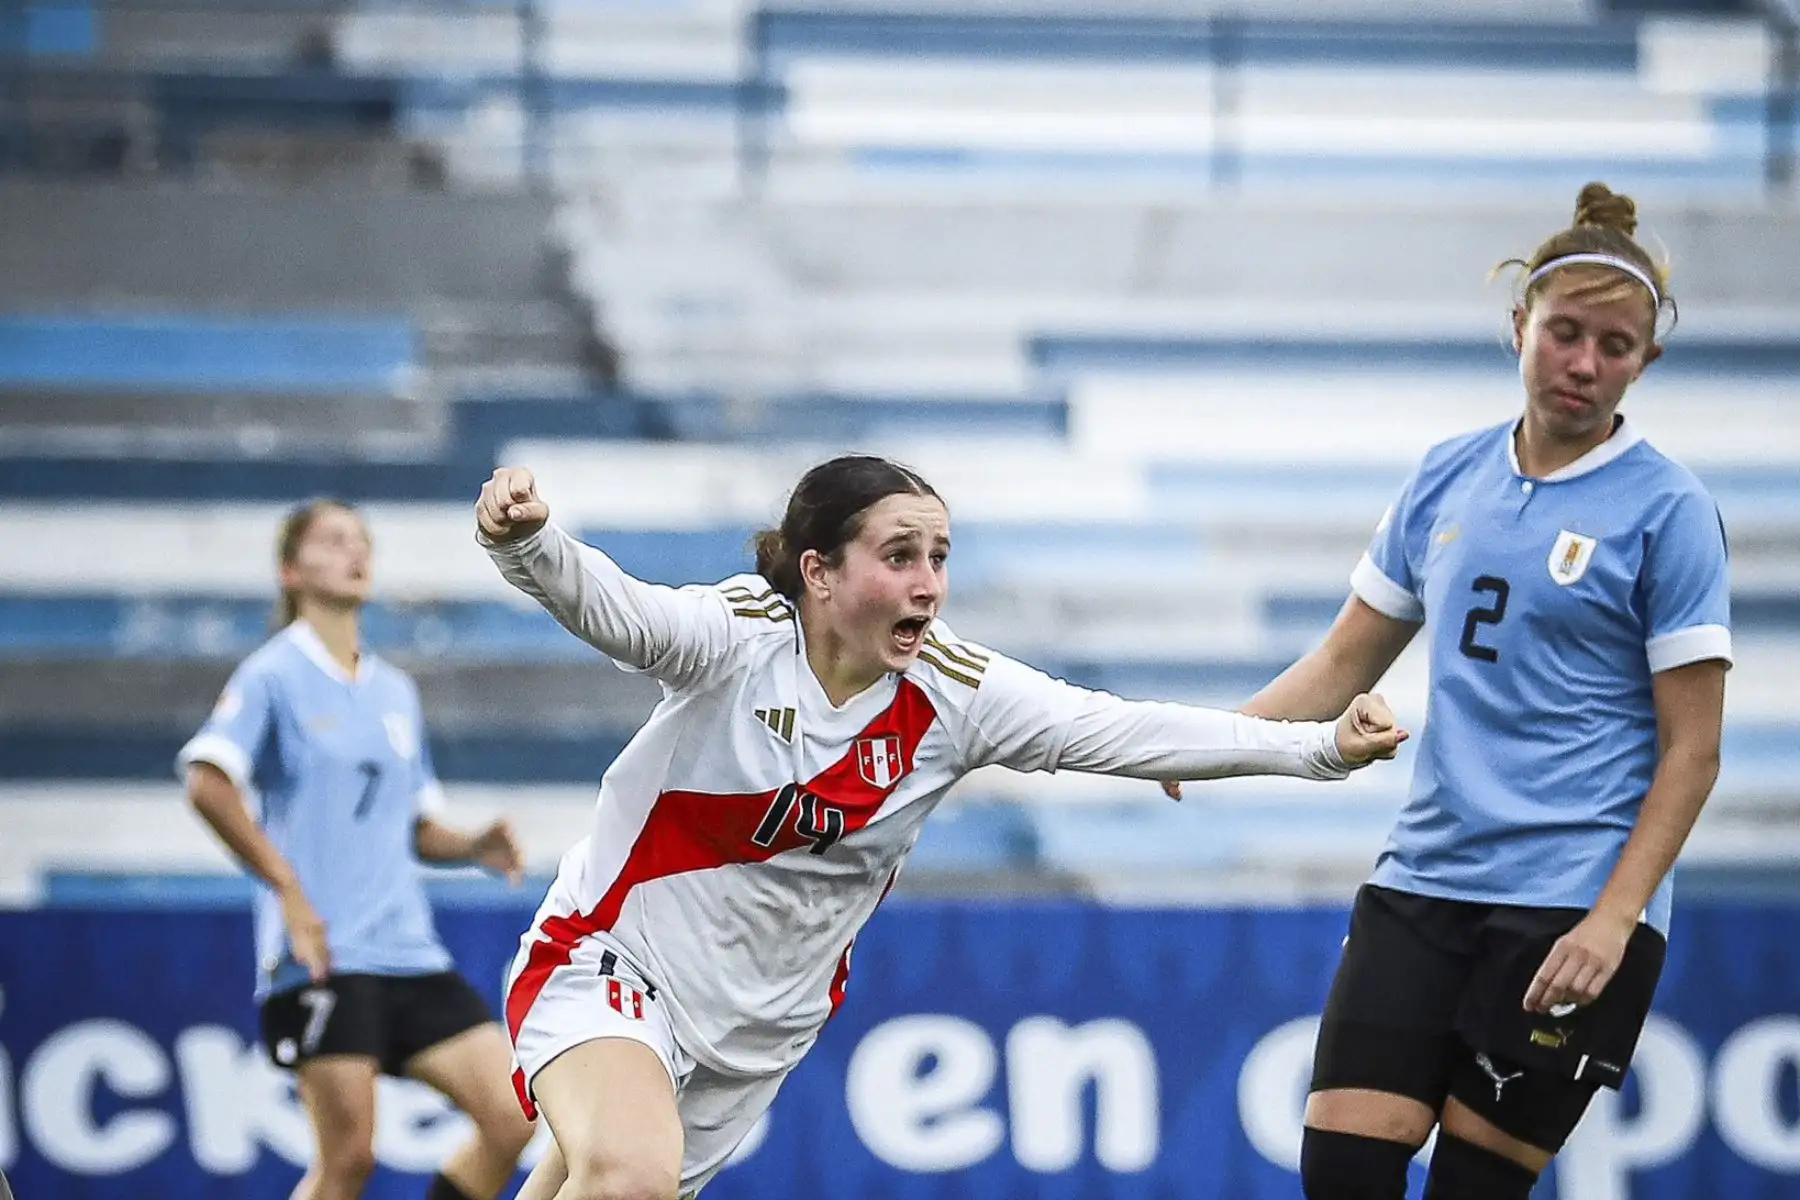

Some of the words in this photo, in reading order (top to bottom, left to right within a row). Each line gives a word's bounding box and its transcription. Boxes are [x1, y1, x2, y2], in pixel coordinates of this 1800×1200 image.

[1459, 574, 1510, 663] 2
[352, 761, 381, 821] 7
[751, 781, 844, 856] 14
[299, 989, 336, 1056] 7
[846, 1014, 1160, 1173] en
